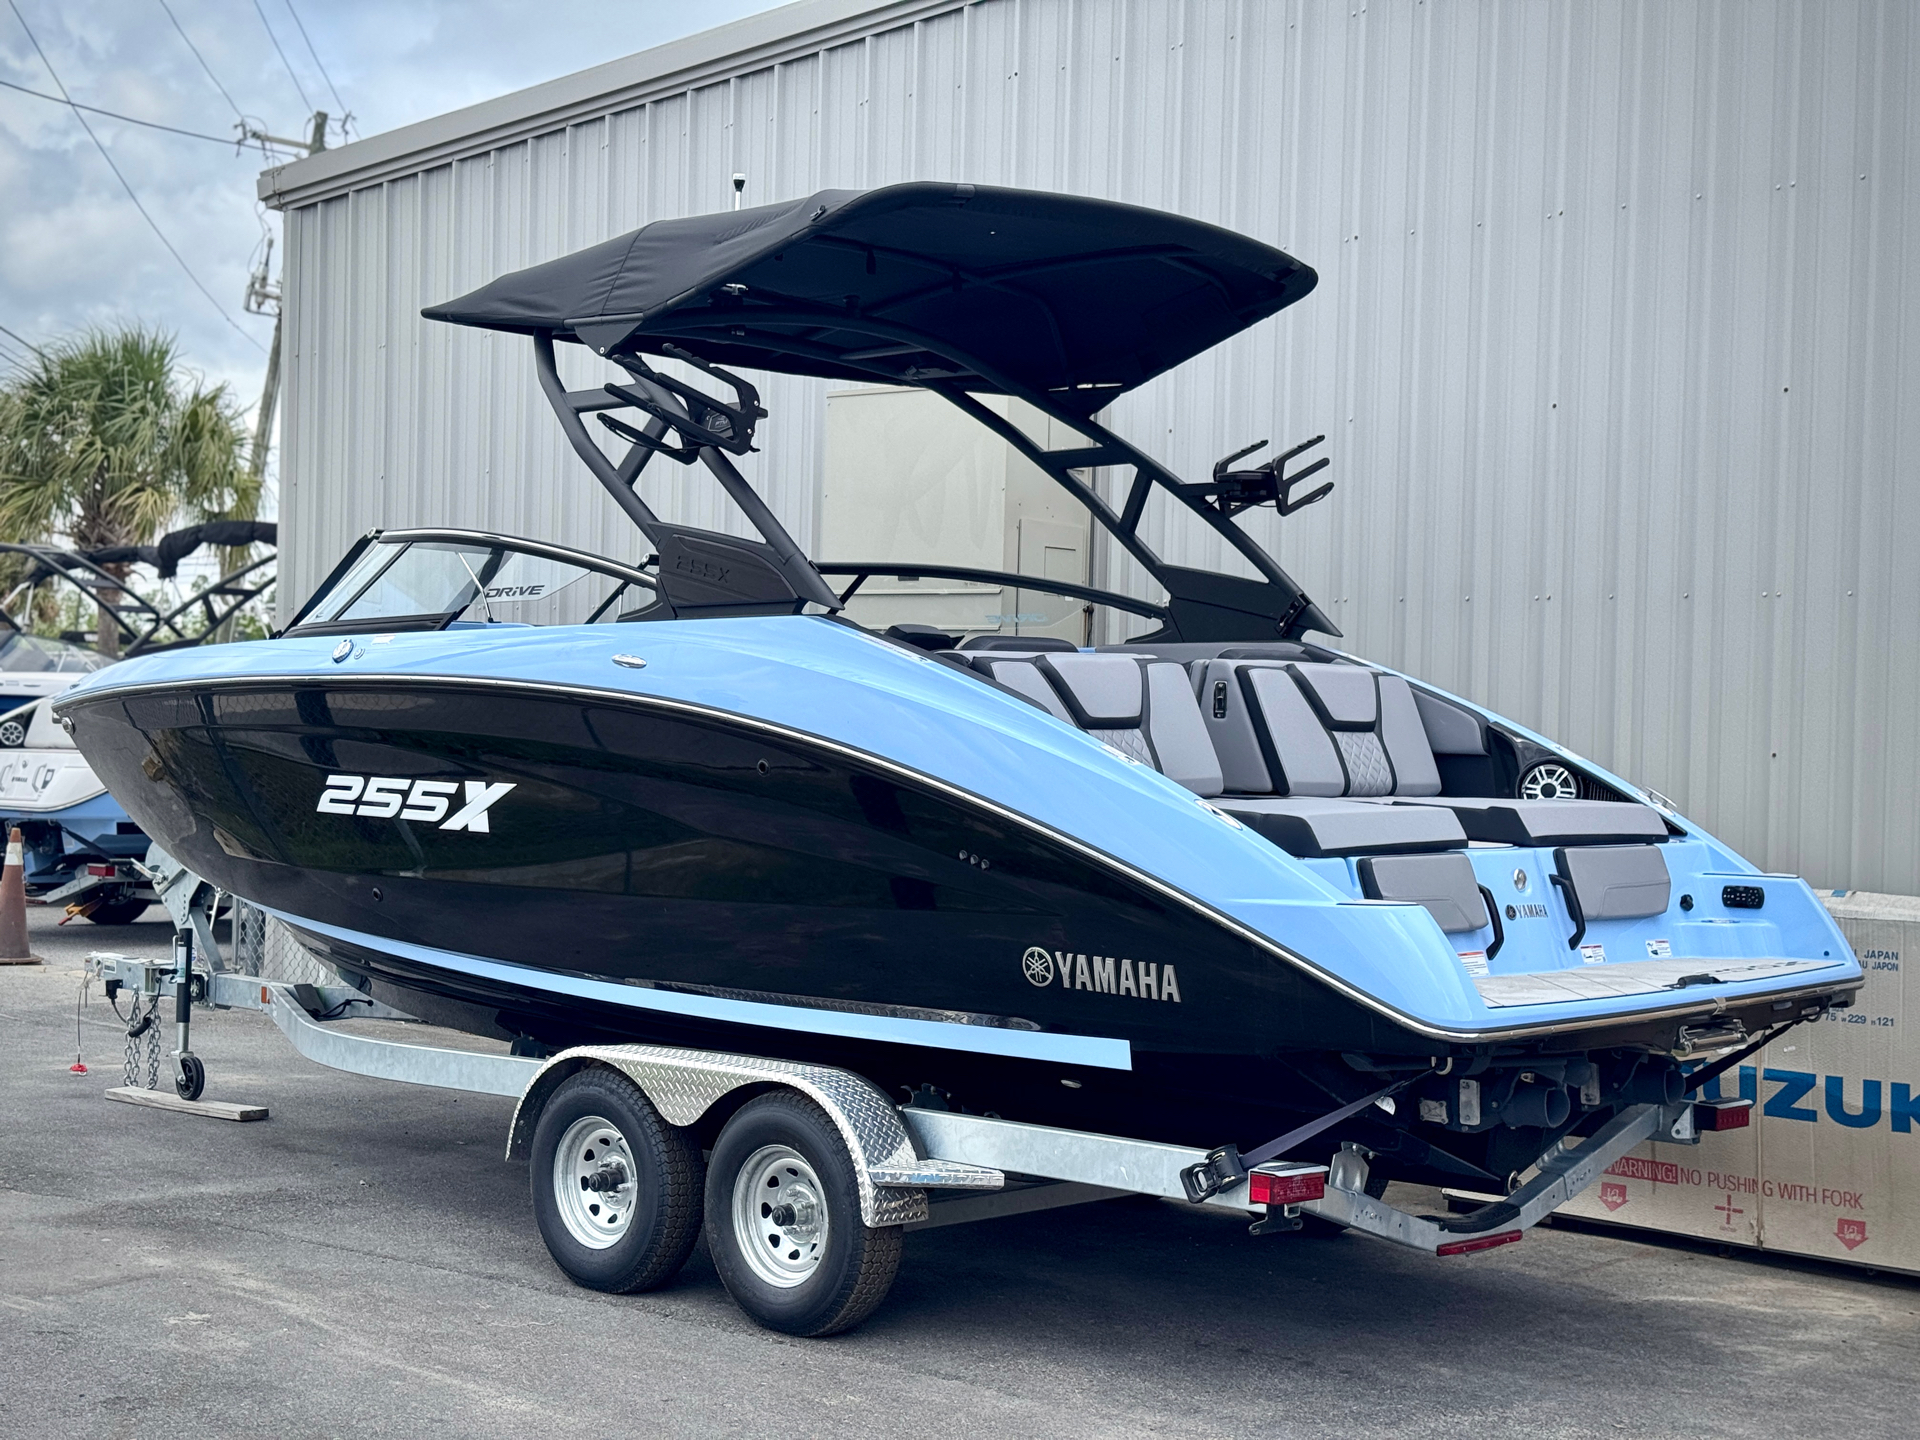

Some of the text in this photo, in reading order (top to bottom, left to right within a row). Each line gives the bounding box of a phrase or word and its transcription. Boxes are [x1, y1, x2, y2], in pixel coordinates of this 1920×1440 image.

[316, 774, 518, 834] 255X
[1515, 904, 1549, 919] YAMAHA
[1864, 949, 1899, 961] JAPAN
[1872, 961, 1899, 972] JAPON
[1054, 950, 1182, 1003] YAMAHA
[1680, 1167, 1702, 1186] NO
[1707, 1172, 1773, 1197] PUSHING
[1778, 1182, 1817, 1204] WITH
[1822, 1188, 1864, 1211] FORK
